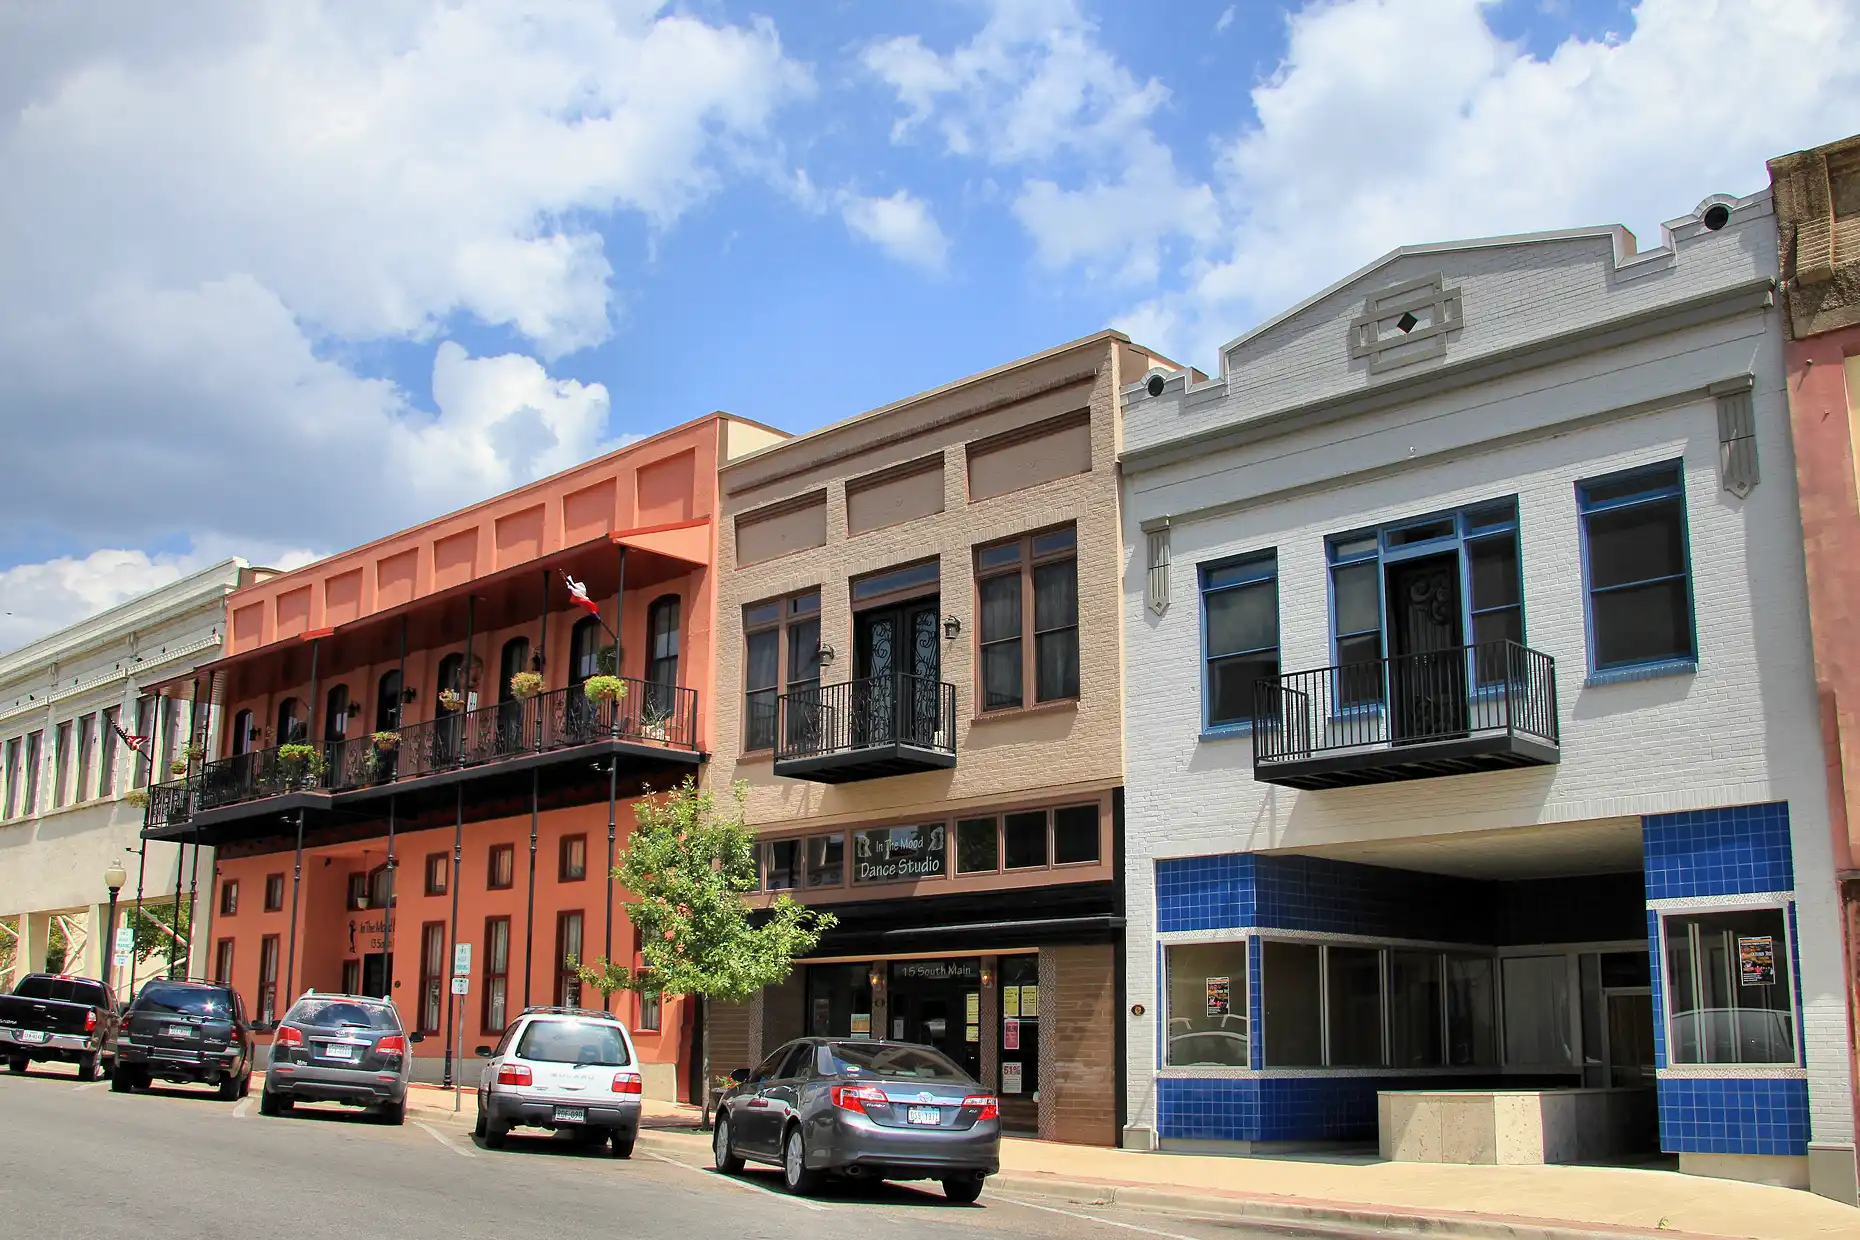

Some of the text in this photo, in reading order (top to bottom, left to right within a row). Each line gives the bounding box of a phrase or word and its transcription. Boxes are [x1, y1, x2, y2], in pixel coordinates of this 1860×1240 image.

[876, 835, 924, 852] In The Mood
[861, 856, 940, 878] Dance Studio
[902, 962, 971, 977] 15 South Main
[1003, 1065, 1021, 1076] 51%
